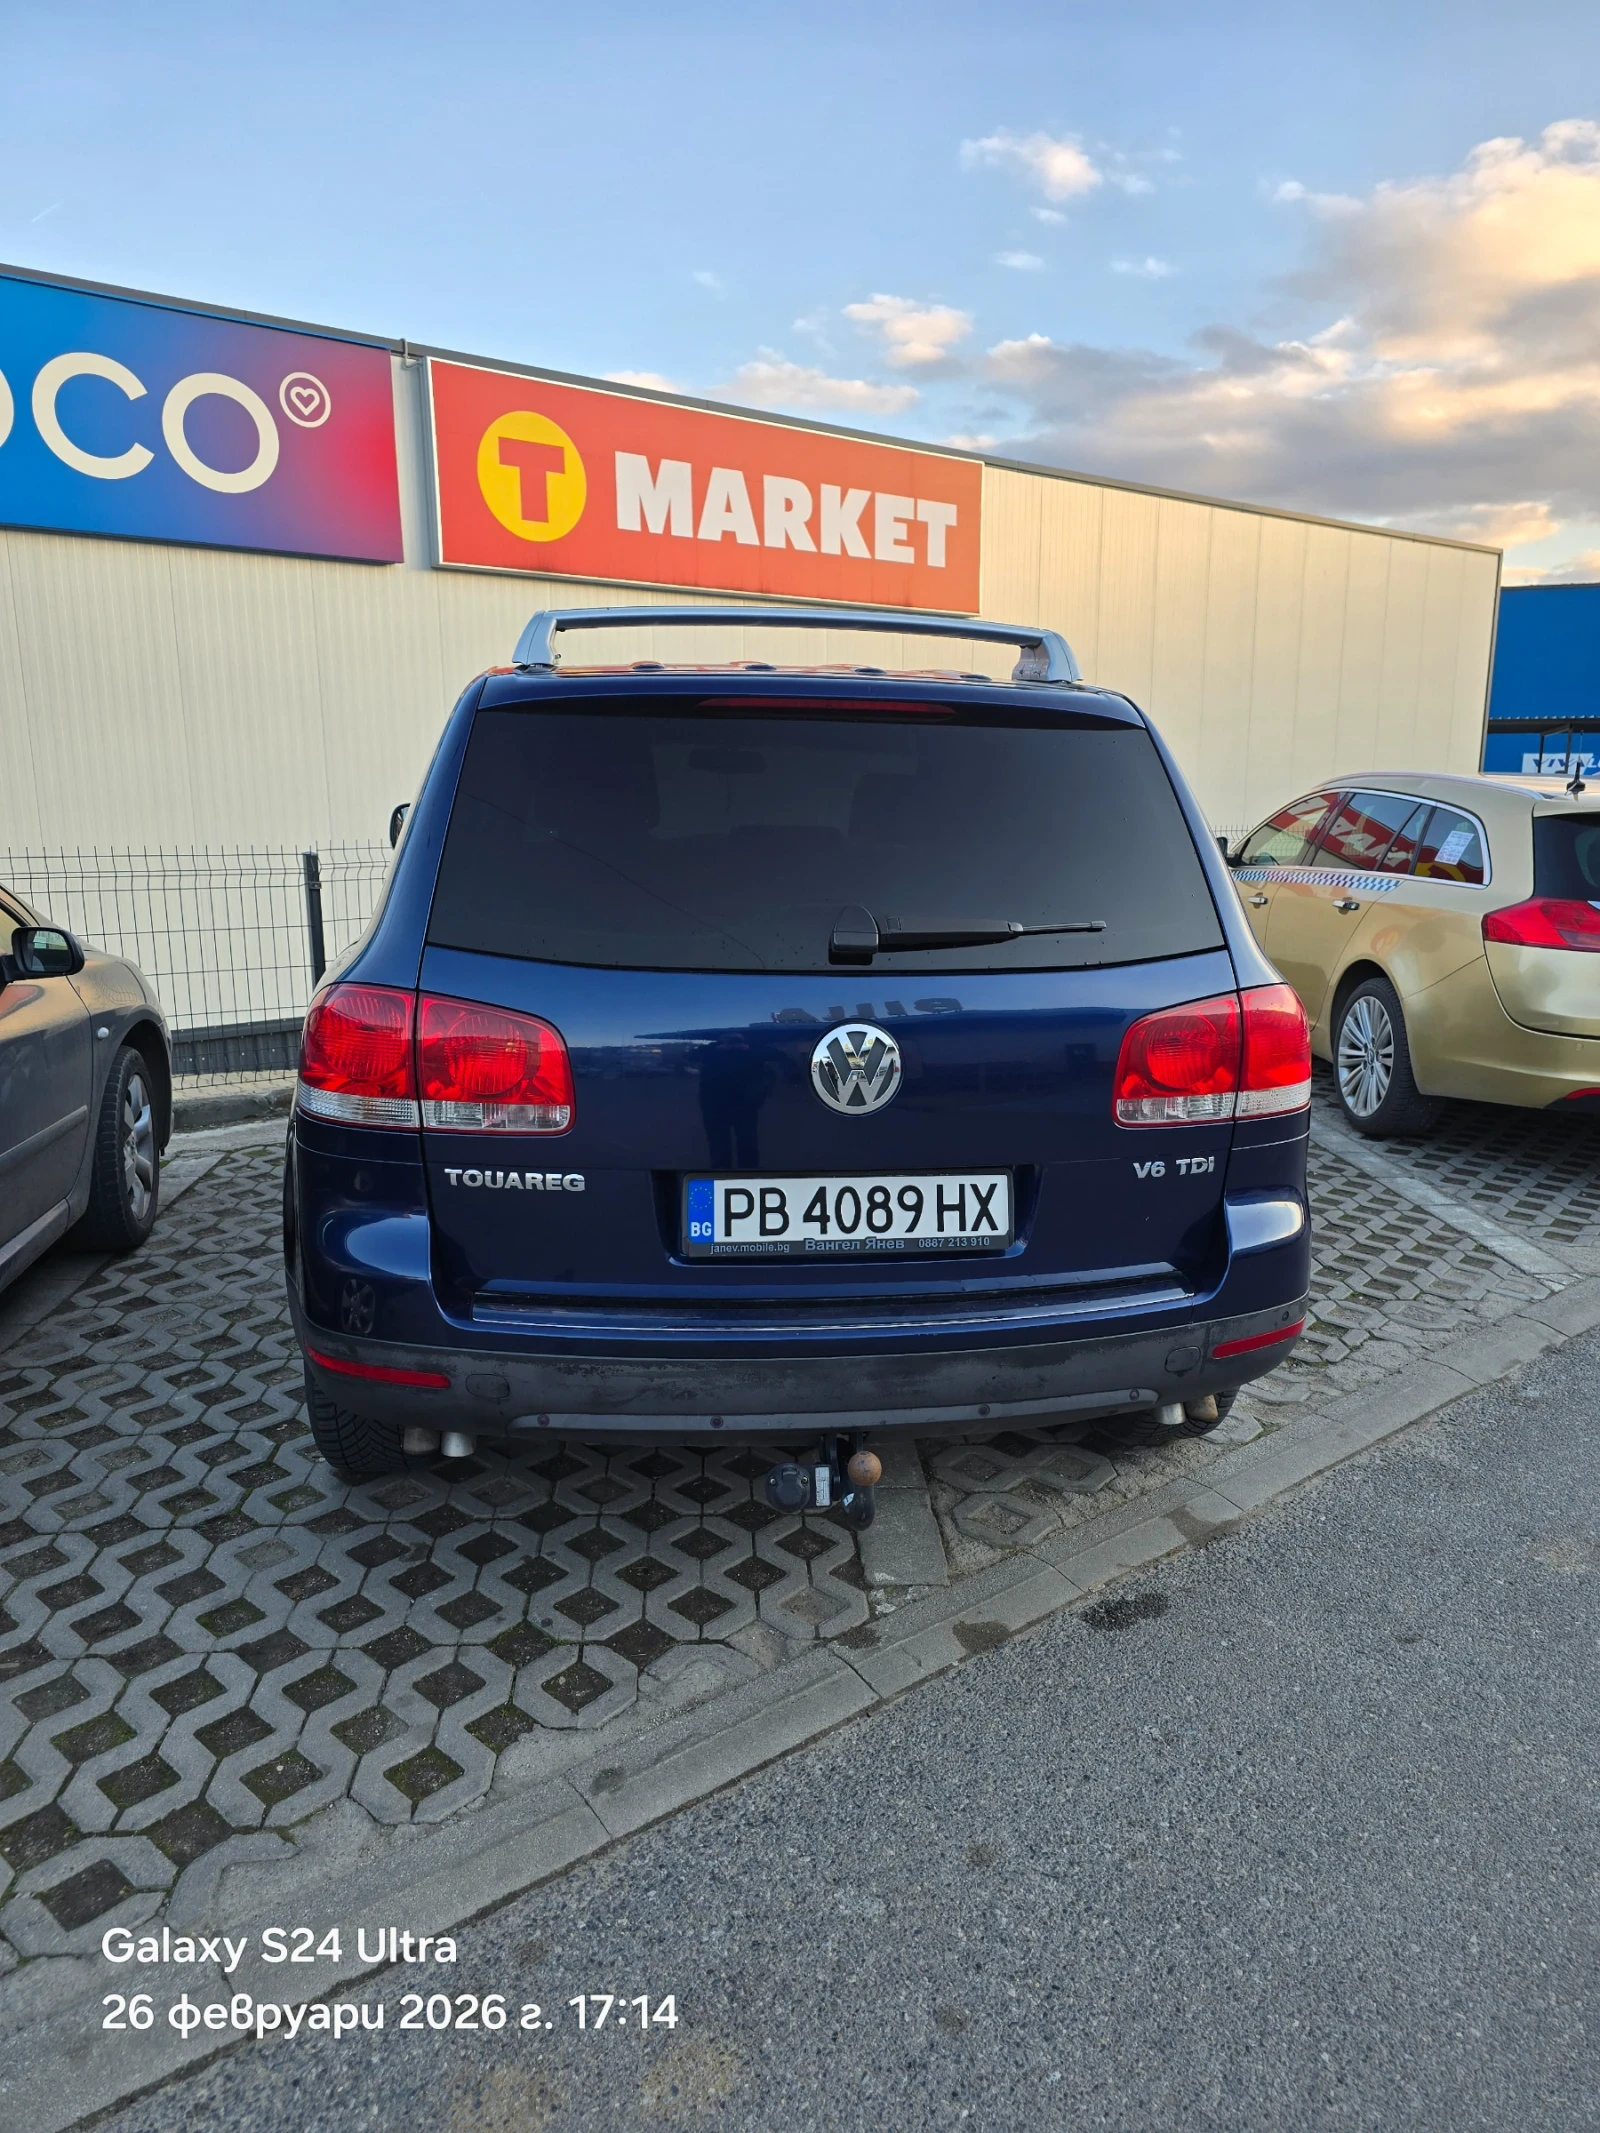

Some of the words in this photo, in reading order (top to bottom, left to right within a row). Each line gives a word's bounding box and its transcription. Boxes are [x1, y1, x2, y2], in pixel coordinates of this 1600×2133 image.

[0, 350, 280, 494] CO
[496, 435, 566, 524] T
[614, 450, 958, 568] MARKET
[1132, 1160, 1166, 1179] V6
[1175, 1156, 1215, 1175] TDI
[444, 1168, 586, 1192] TOUAREG
[723, 1186, 790, 1237] PB
[802, 1184, 925, 1235] 4089
[935, 1182, 999, 1233] HX
[690, 1221, 712, 1237] BG
[710, 1242, 790, 1254] janev.mobile.bg
[804, 1239, 860, 1251] Вангел
[865, 1238, 905, 1249] Янев
[918, 1238, 945, 1248] 0887
[947, 1237, 968, 1247] 213
[970, 1236, 990, 1246] 910
